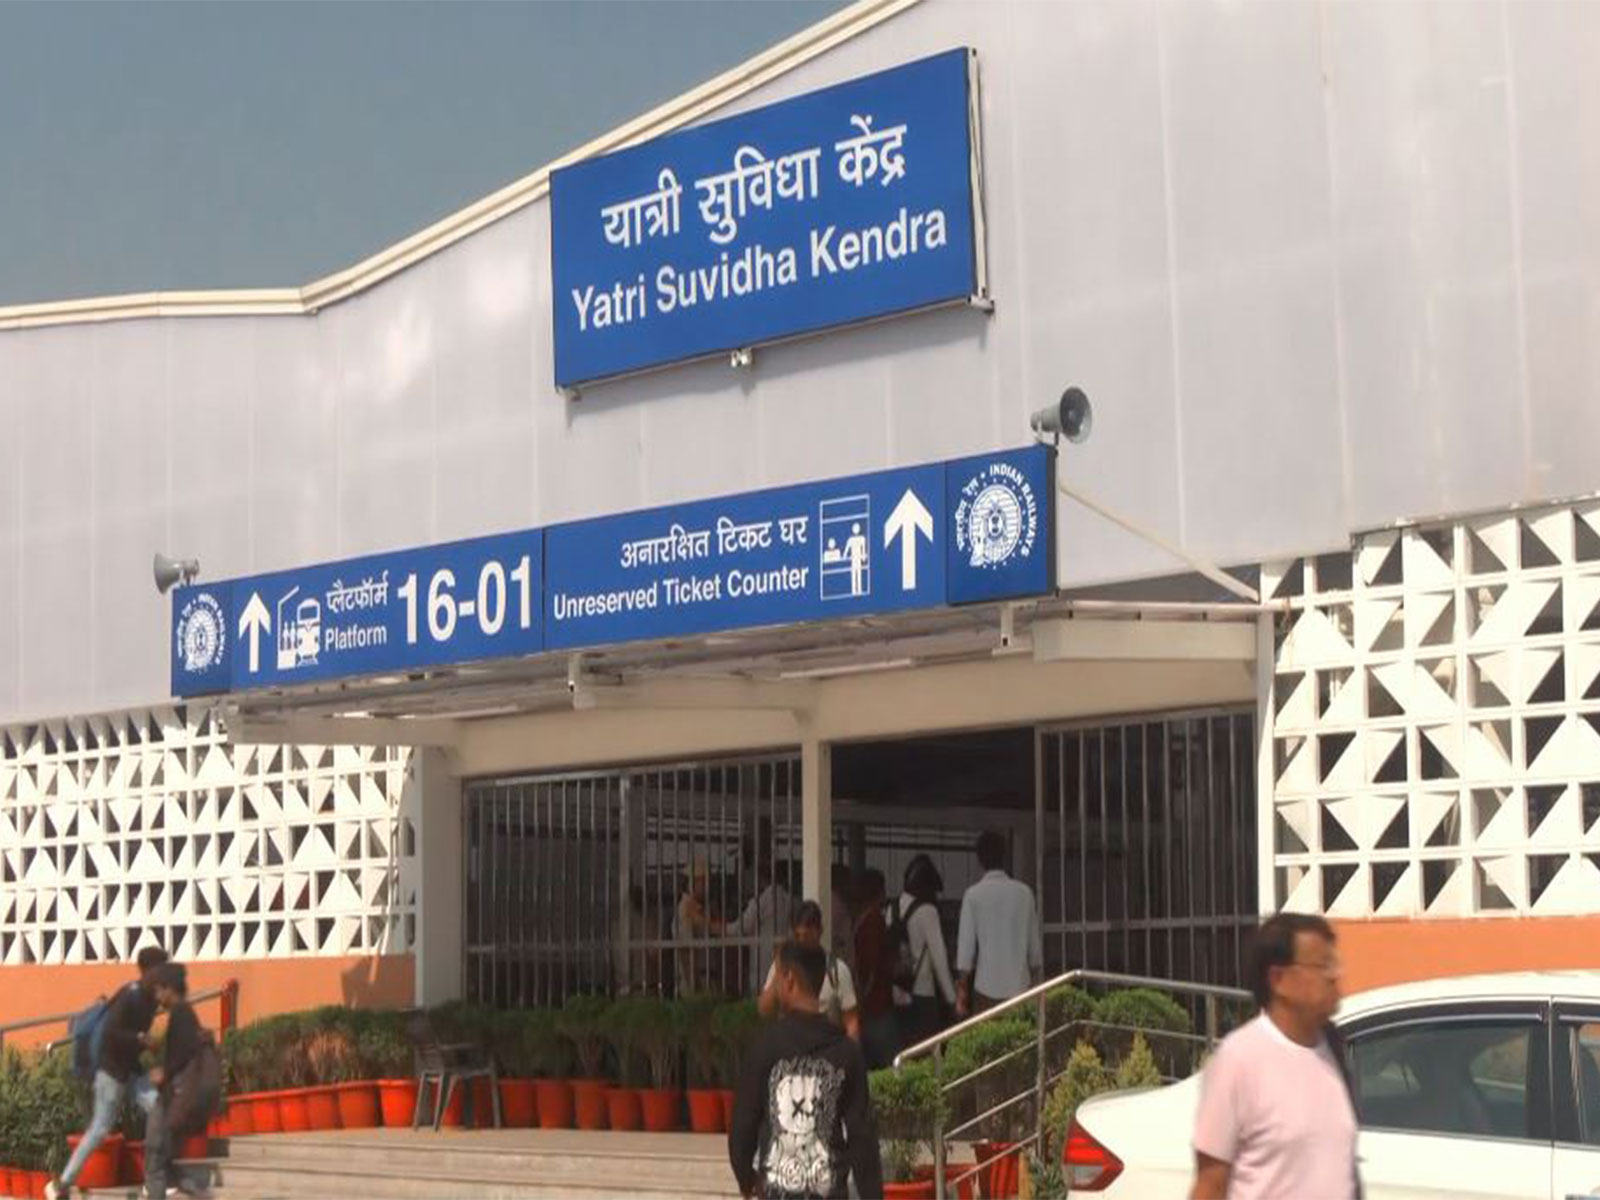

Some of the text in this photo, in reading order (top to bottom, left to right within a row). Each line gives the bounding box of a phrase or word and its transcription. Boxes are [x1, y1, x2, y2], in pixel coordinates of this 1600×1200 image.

[602, 114, 908, 249] यात्री सुविधा केंद्र
[571, 207, 947, 331] Yatri Suvidha Kendra
[620, 515, 809, 568] अनारक्षित टिकट घर
[397, 554, 532, 644] 16-01
[553, 565, 809, 620] Unreserved Ticket Counter
[324, 623, 388, 652] Platform
